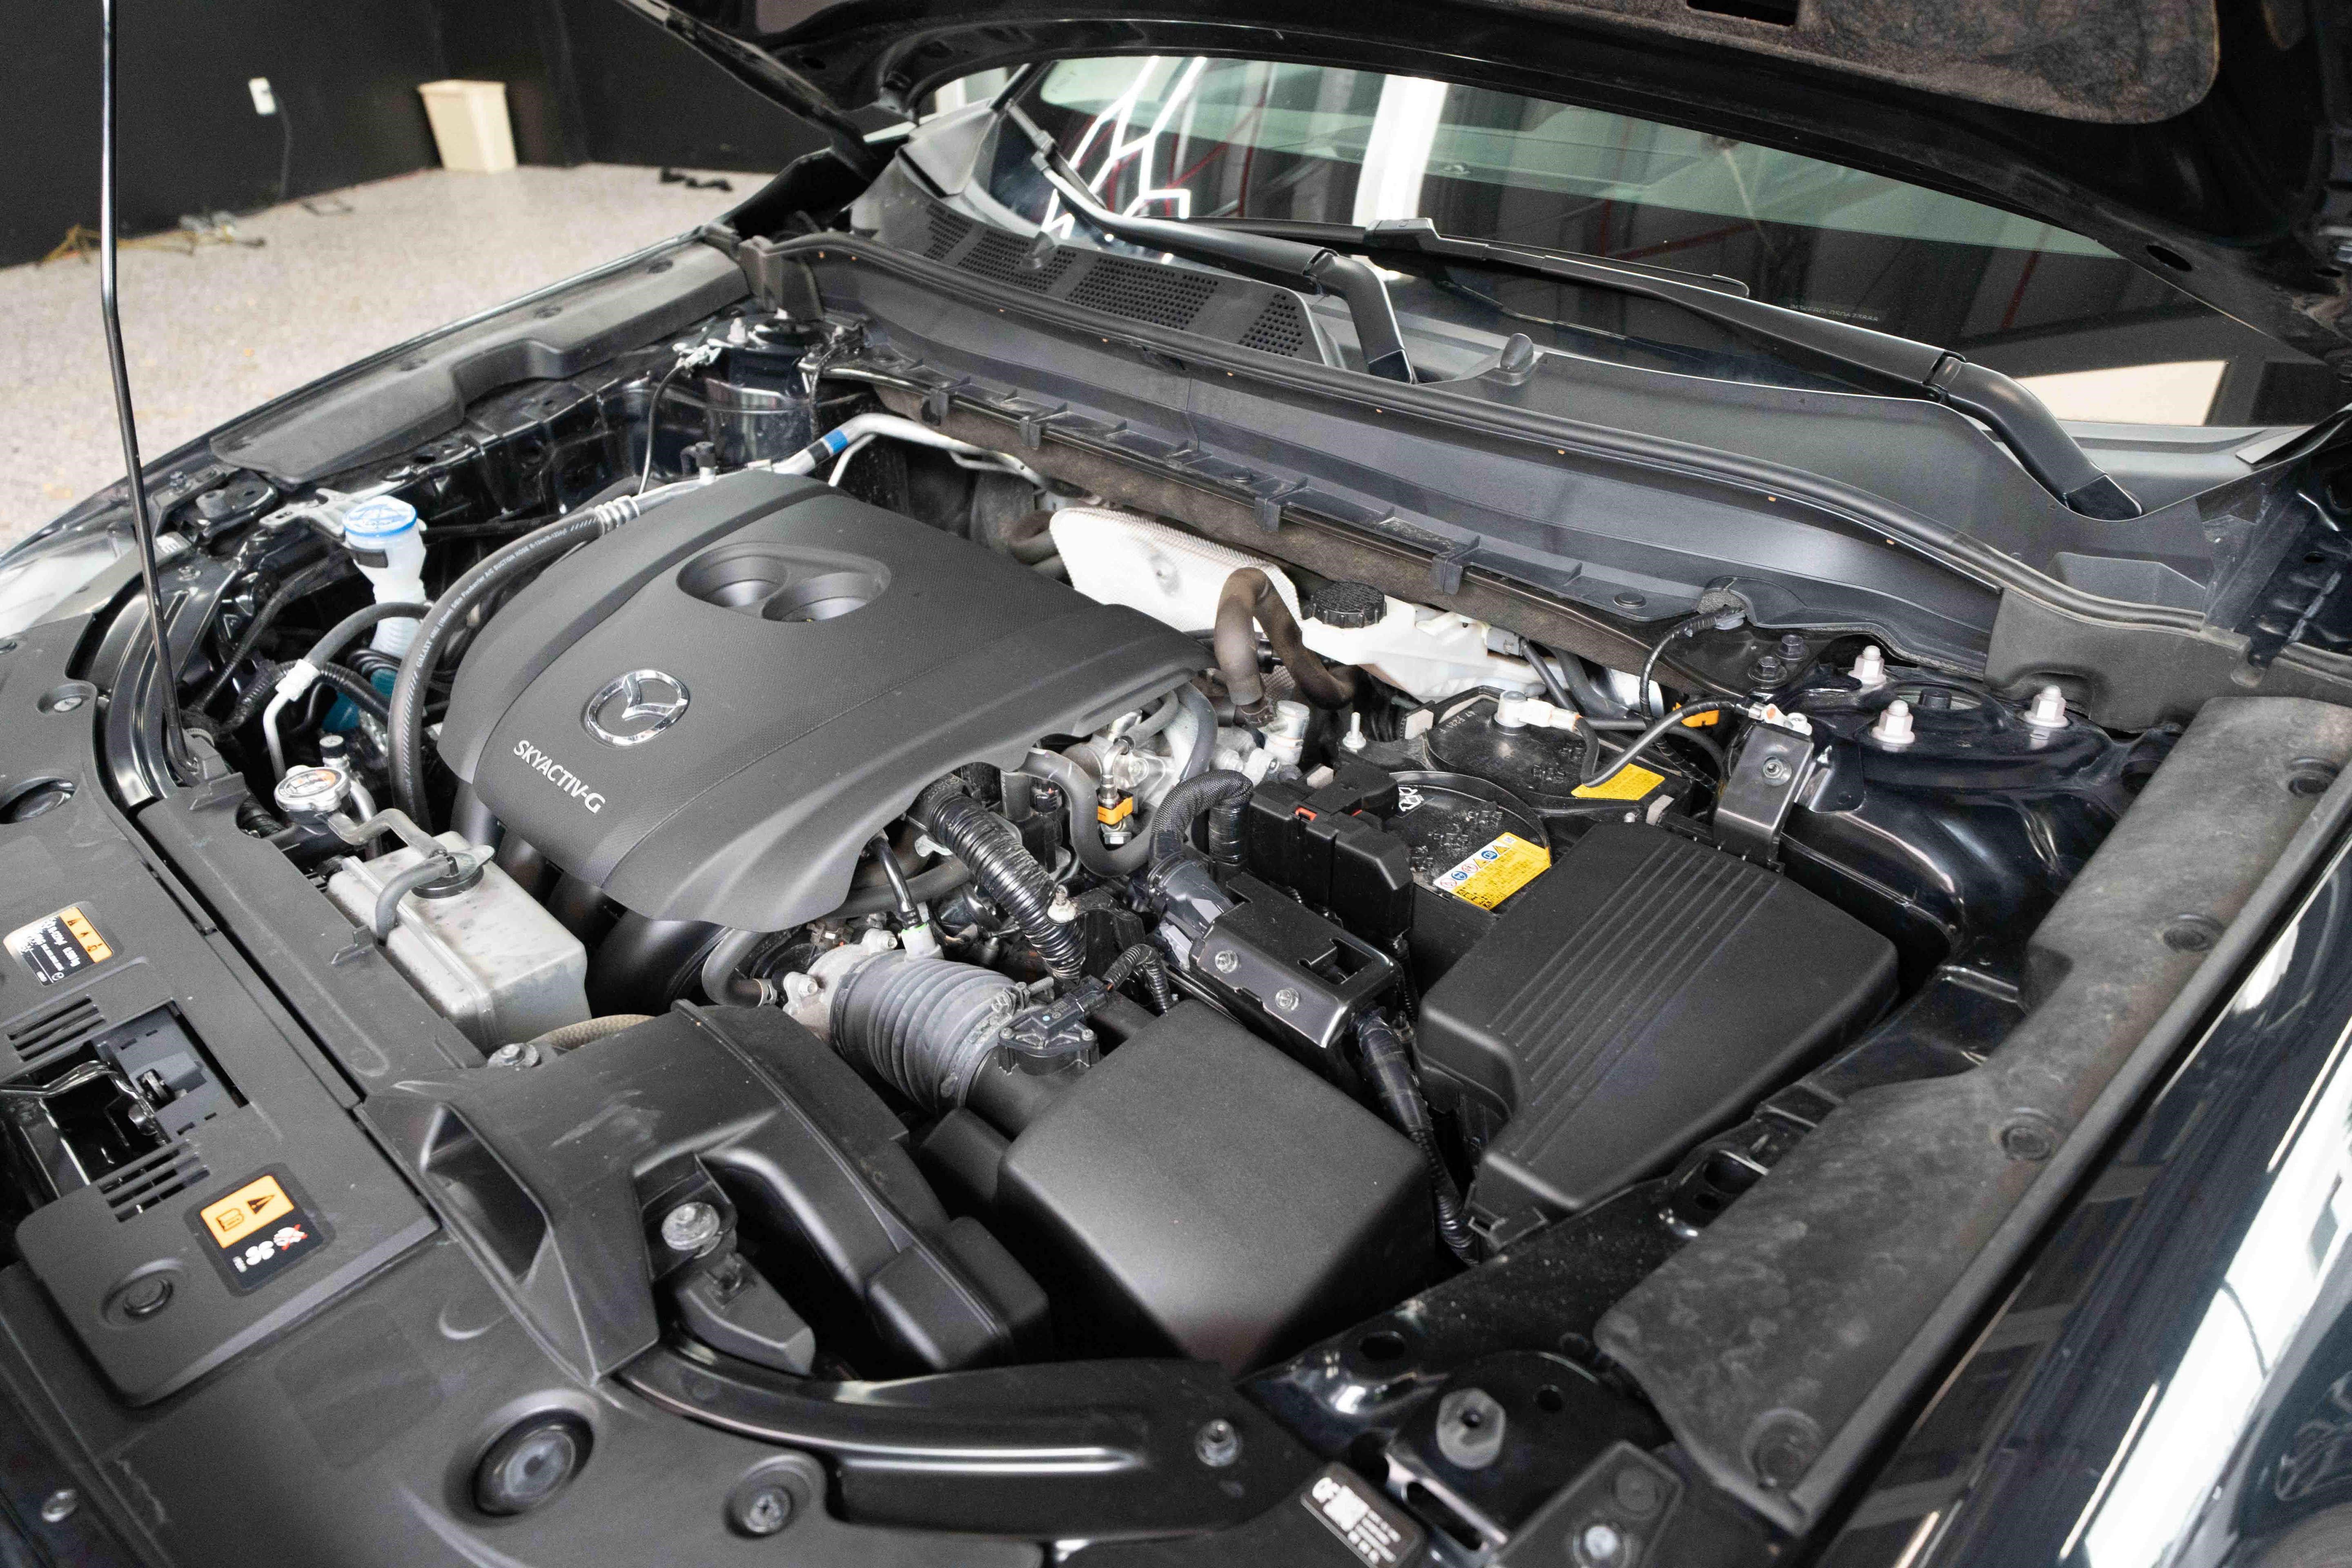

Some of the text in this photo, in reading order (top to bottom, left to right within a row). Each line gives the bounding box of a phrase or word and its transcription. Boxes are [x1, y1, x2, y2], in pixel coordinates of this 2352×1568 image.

[416, 639, 433, 668] GALAXY
[493, 555, 515, 571] SUCTION
[515, 546, 530, 558] HOSE
[513, 740, 606, 814] SKYACTIV-G
